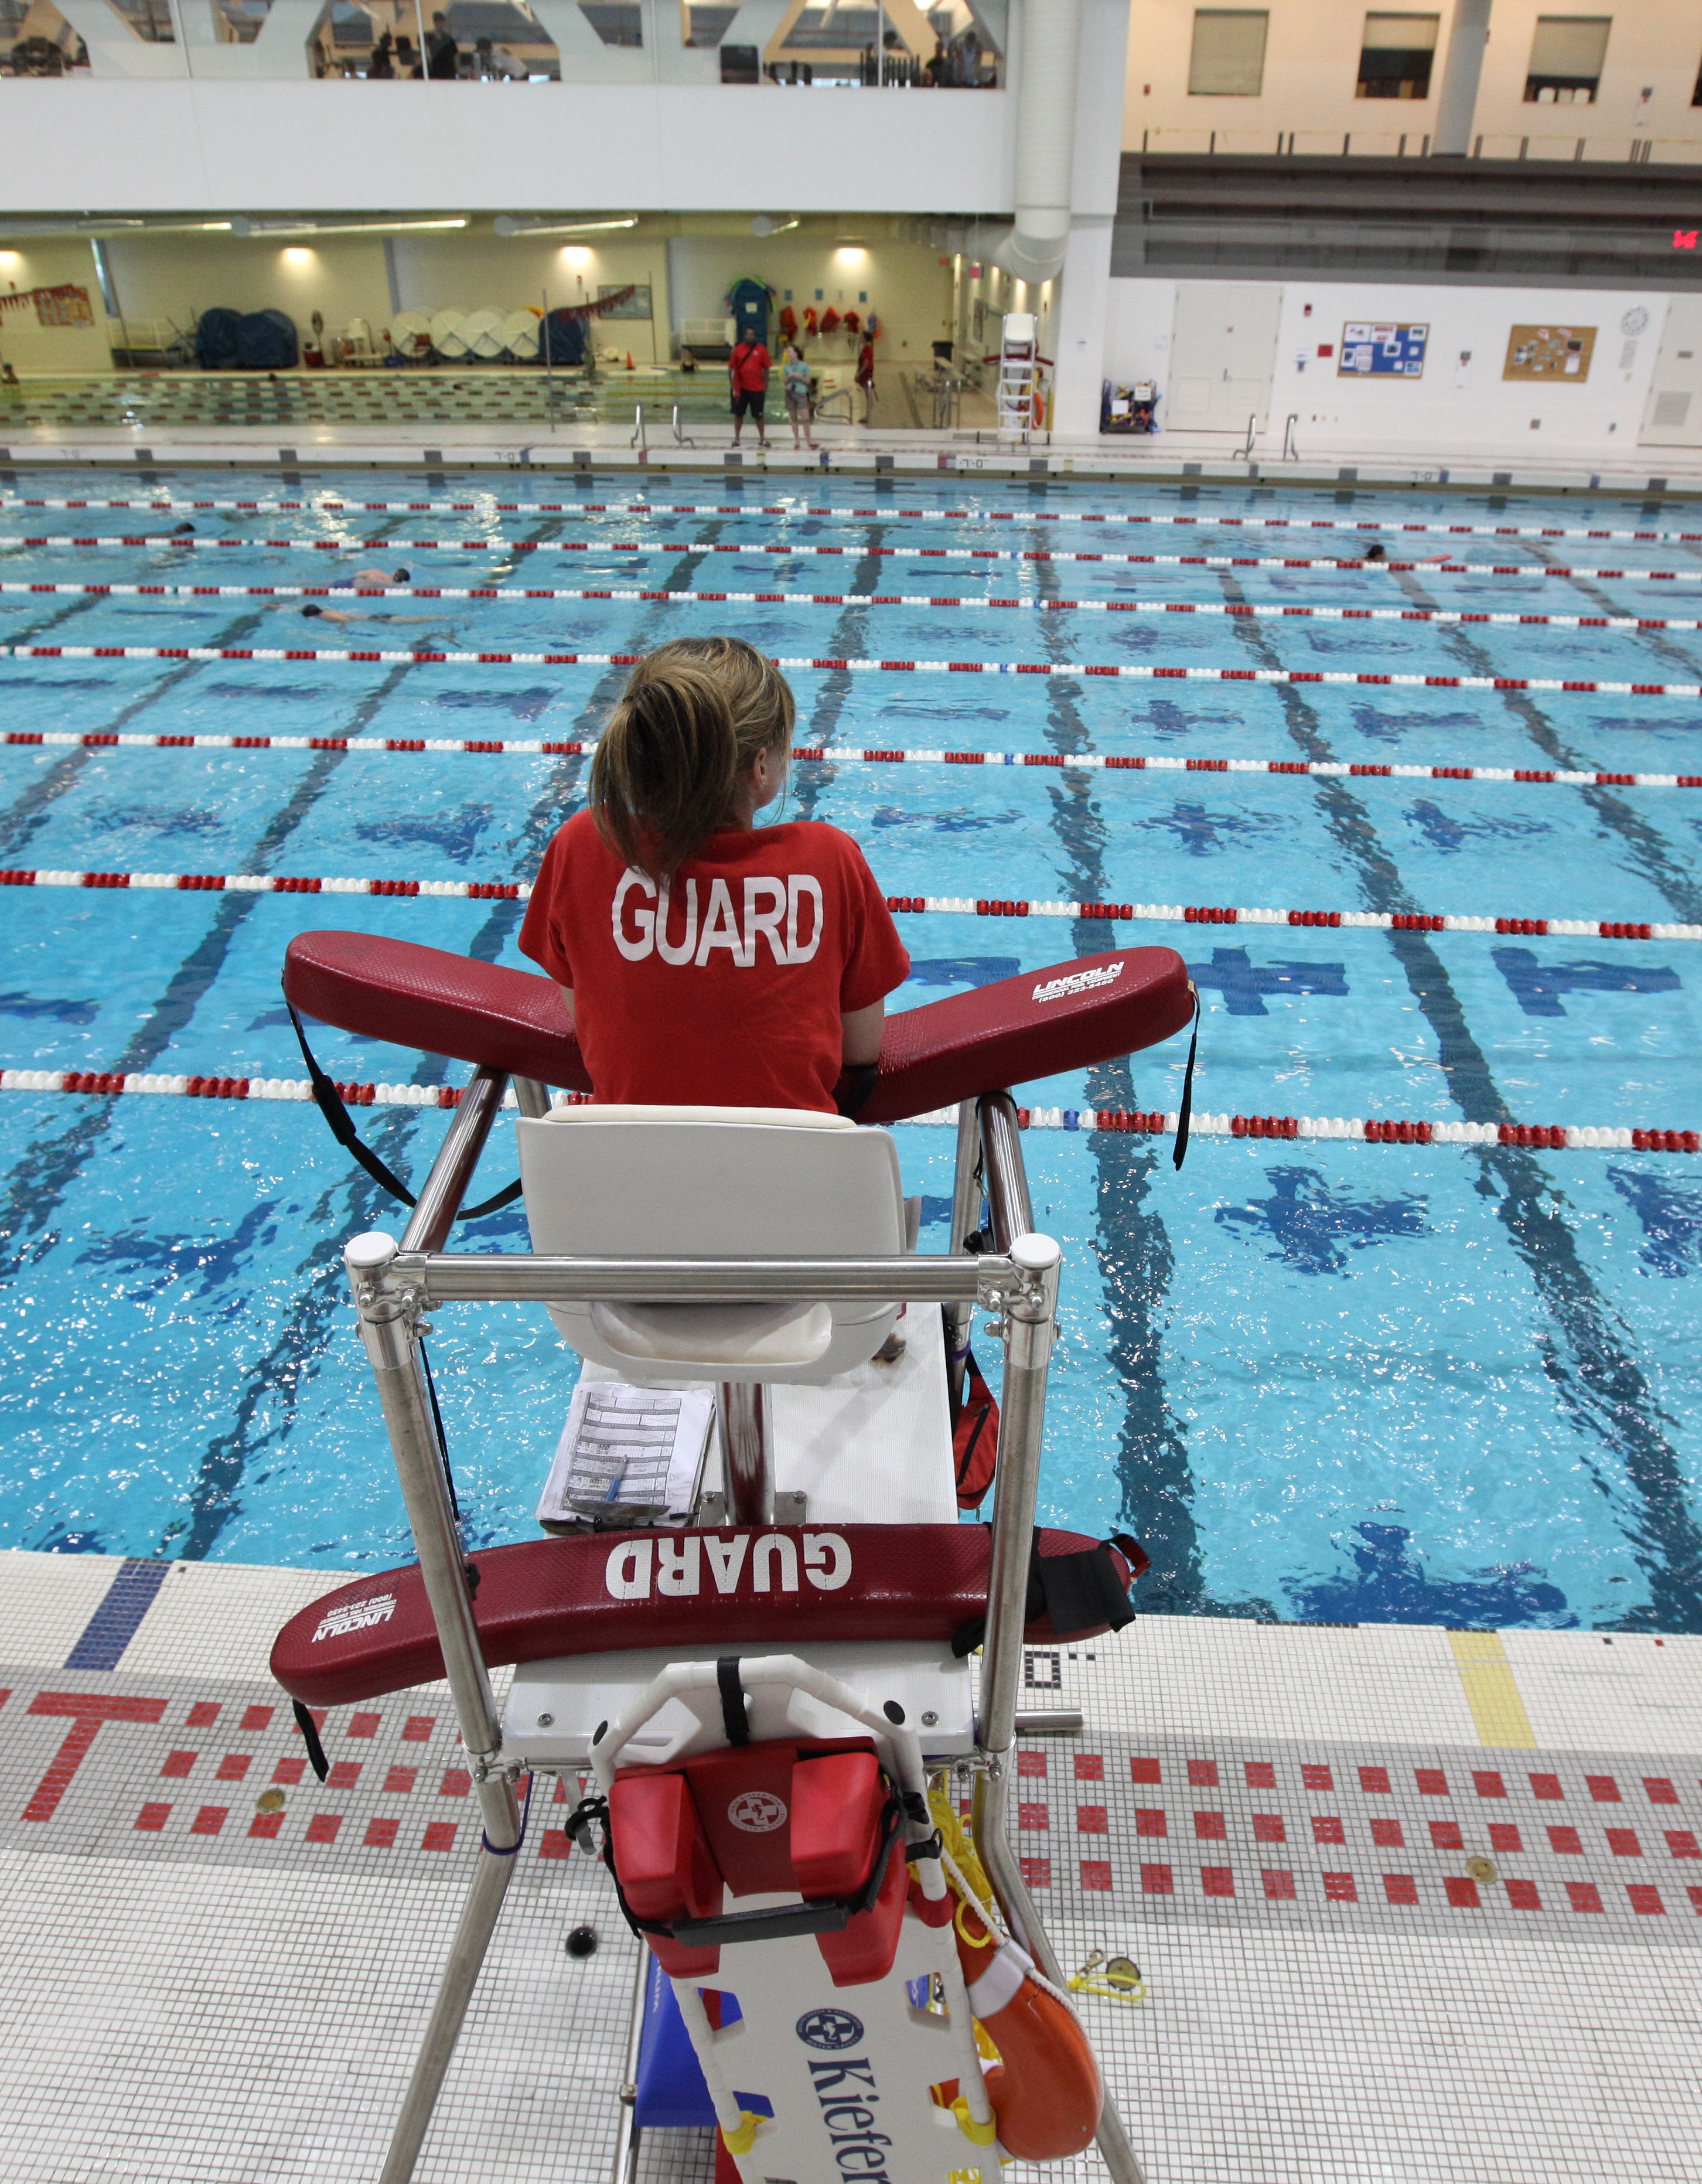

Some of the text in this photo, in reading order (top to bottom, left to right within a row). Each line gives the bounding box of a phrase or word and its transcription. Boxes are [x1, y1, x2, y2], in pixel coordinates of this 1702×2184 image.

[612, 865, 824, 967] GUARD
[1033, 961, 1125, 994] LINCOLN
[1038, 991, 1065, 1003] (800)
[605, 1532, 852, 1600] GUARD
[368, 1593, 393, 1606] (800)
[311, 1608, 395, 1643] LINCOLN
[807, 2057, 892, 2184] Kiefer
